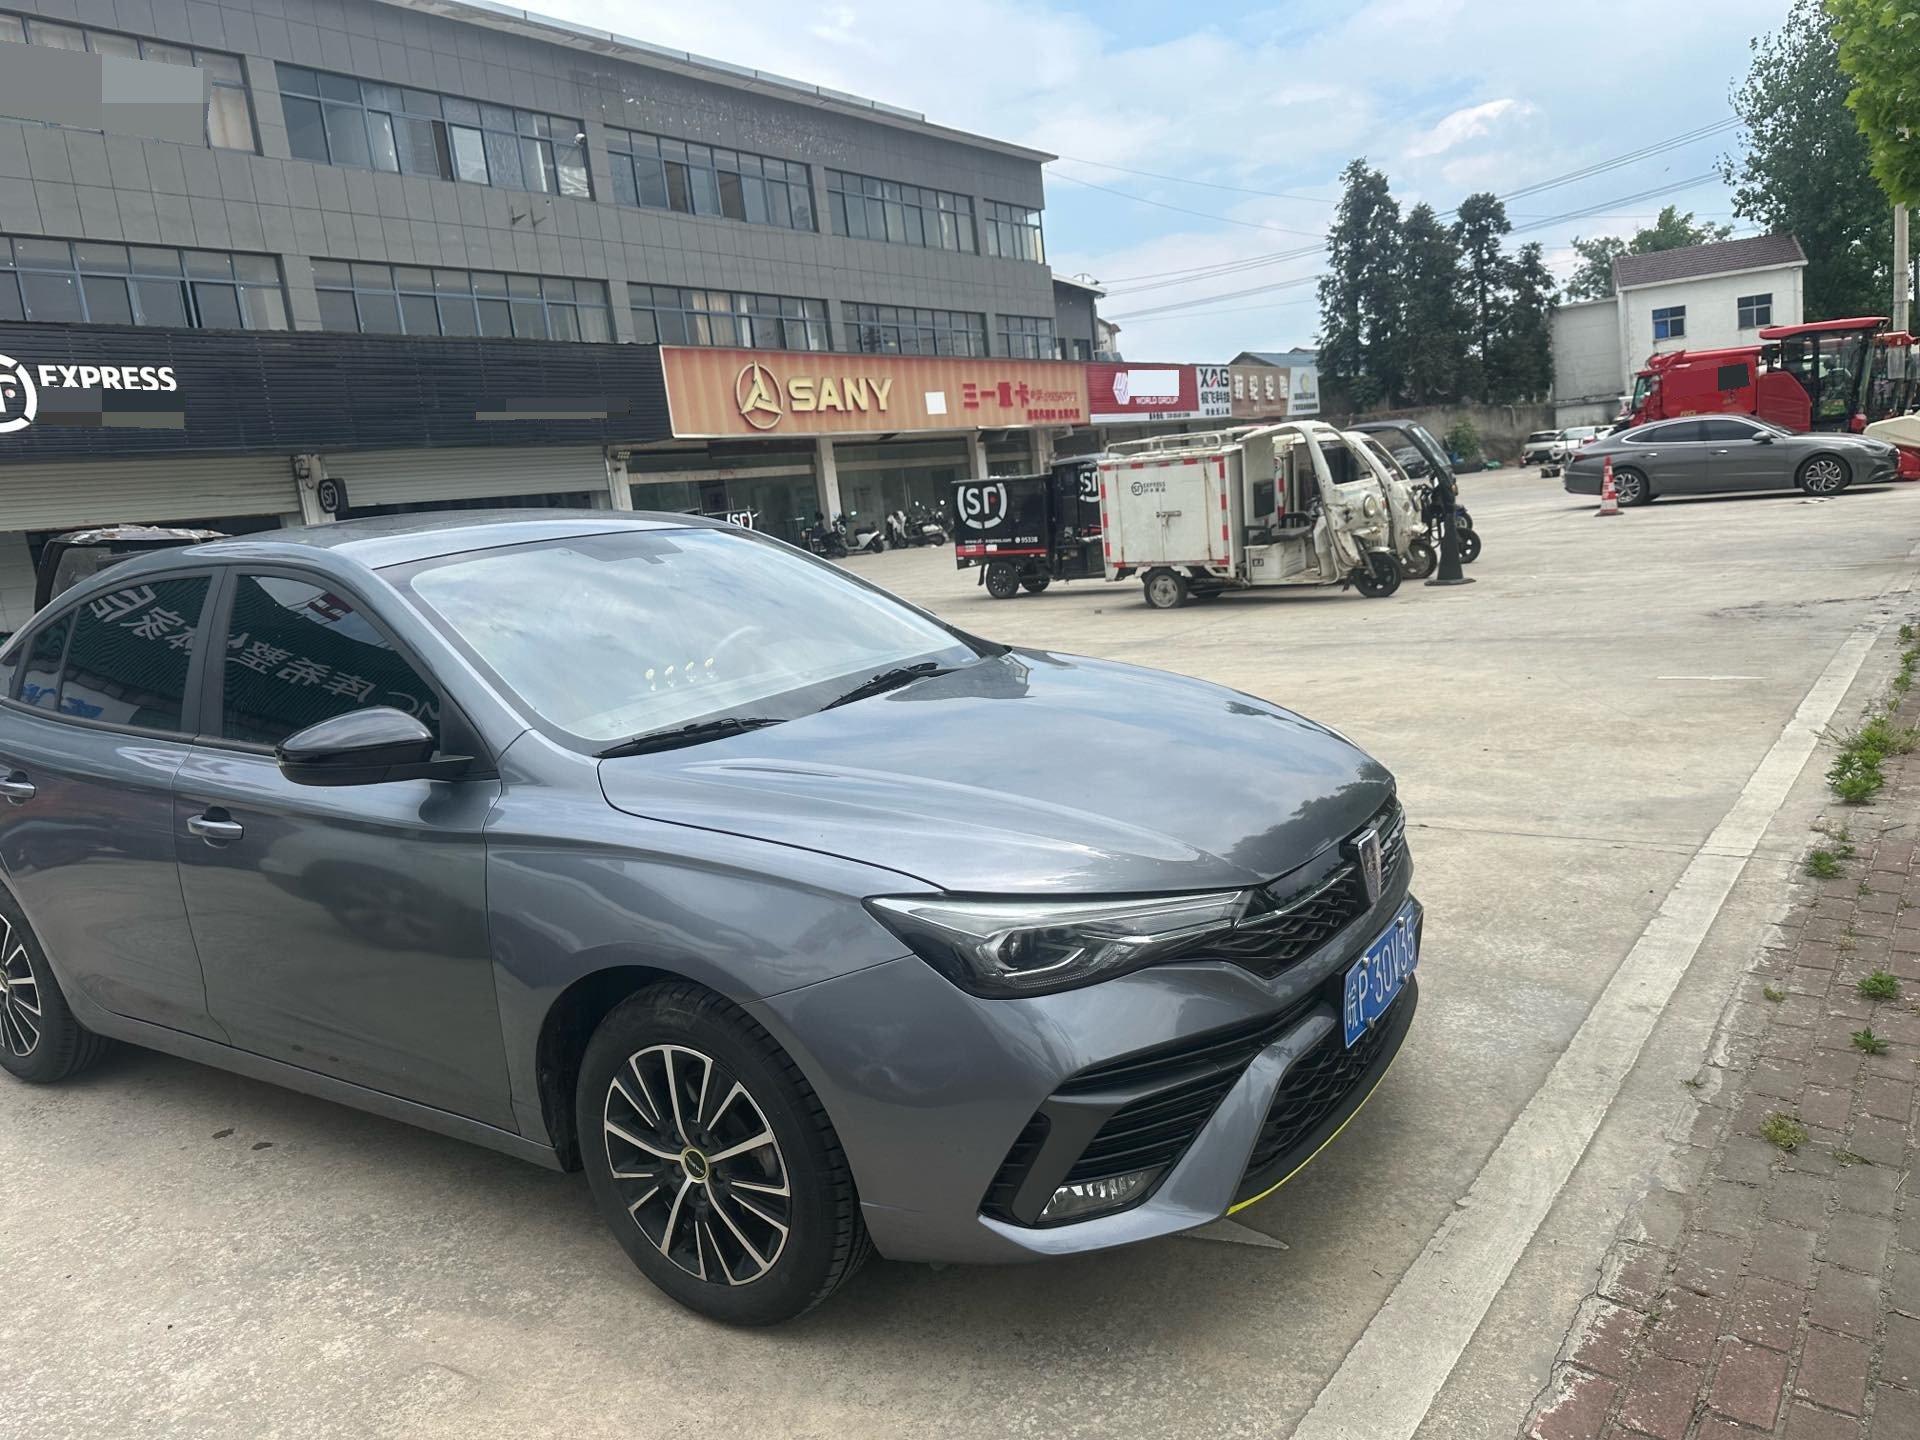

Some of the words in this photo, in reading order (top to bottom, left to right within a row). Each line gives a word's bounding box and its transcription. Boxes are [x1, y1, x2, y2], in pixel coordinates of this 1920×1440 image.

[38, 365, 177, 392] EXPRESS
[1200, 368, 1229, 387] XAG
[788, 376, 893, 412] SANY
[1135, 397, 1157, 405] WORLD
[1158, 396, 1179, 404] GROUP
